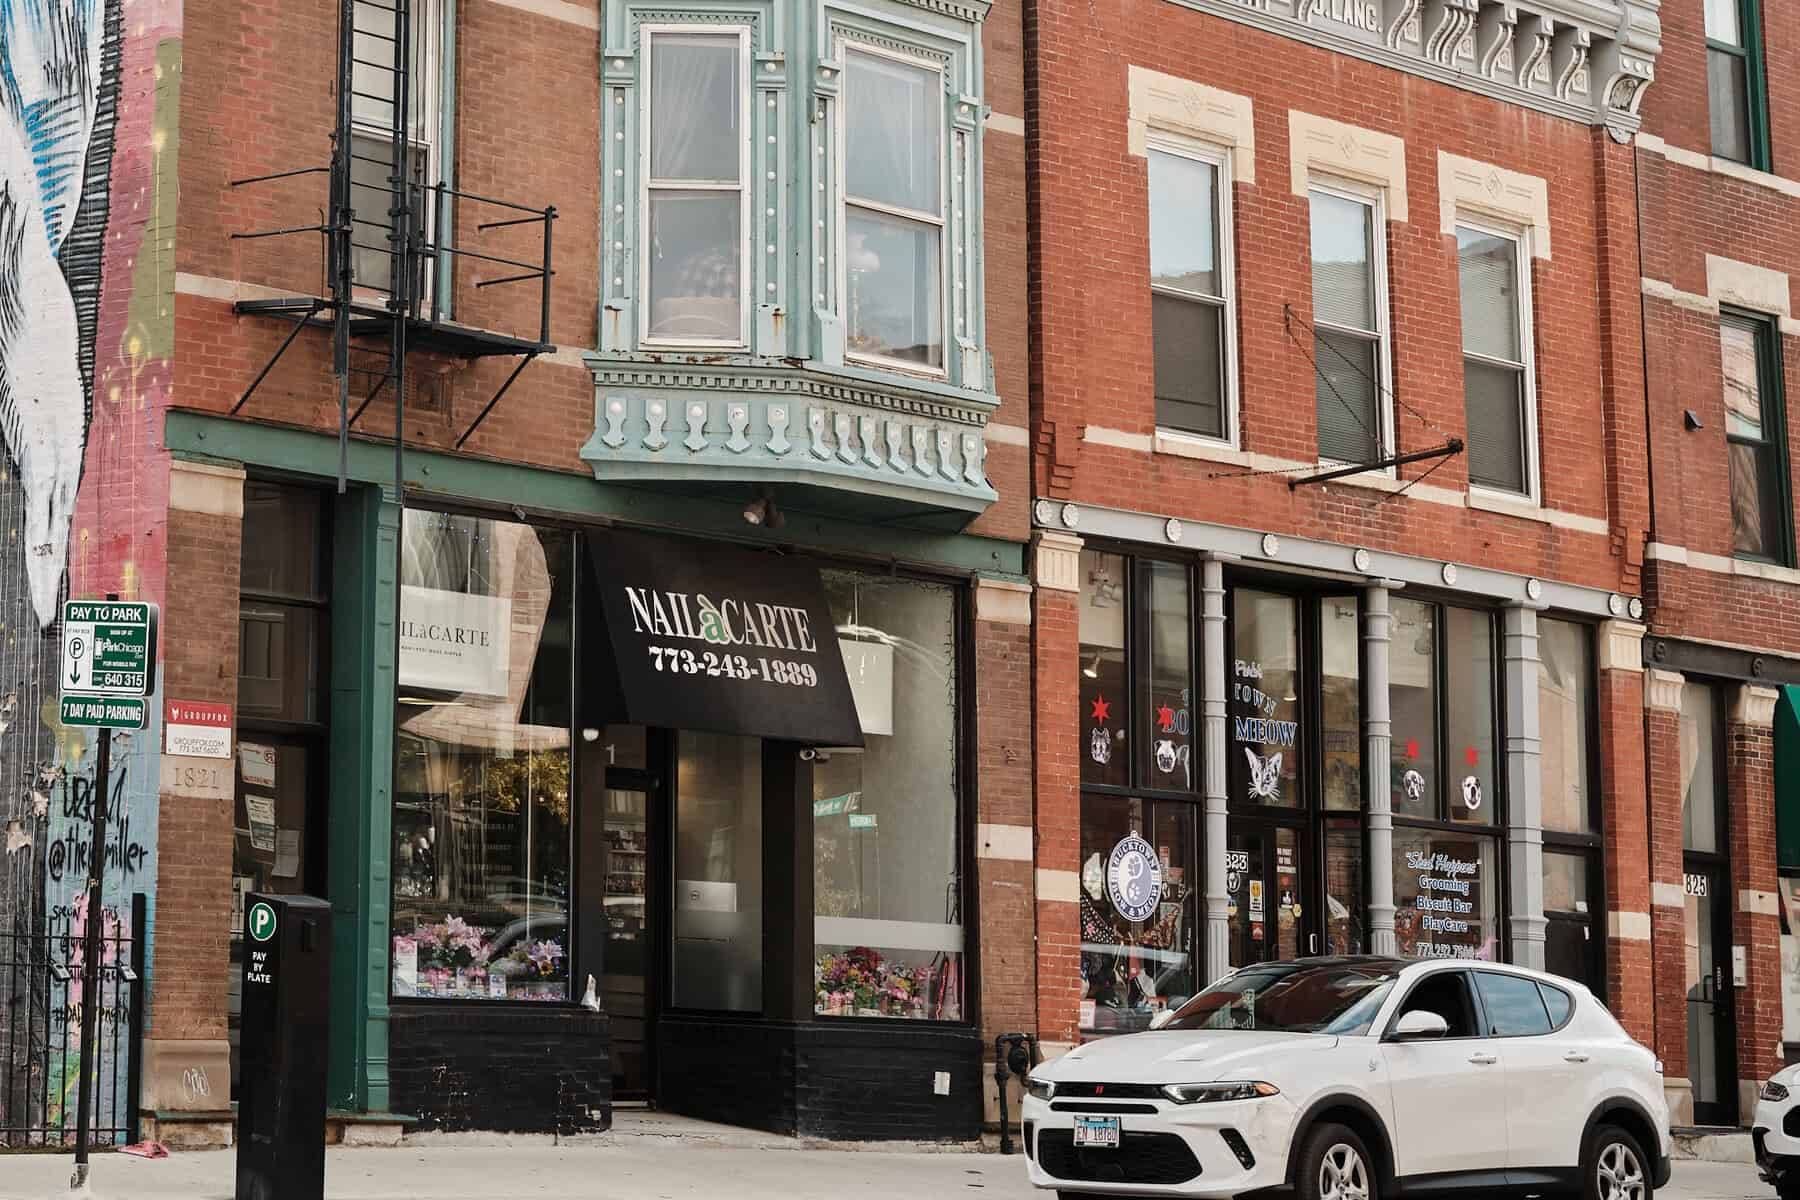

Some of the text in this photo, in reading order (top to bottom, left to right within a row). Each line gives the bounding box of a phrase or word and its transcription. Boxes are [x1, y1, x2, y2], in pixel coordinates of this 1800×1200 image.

[71, 607, 142, 621] PAY TO PARK
[649, 645, 818, 687] 773-243-1889
[104, 674, 122, 686] 640
[124, 674, 143, 686] 315
[63, 703, 142, 721] 7 DAY PAID PARKING
[183, 711, 228, 722] GROUPFOX
[1235, 716, 1298, 747] MEOW
[173, 766, 220, 790] 1821
[1419, 874, 1470, 896] Grooming
[1686, 875, 1706, 895] 825
[1416, 896, 1473, 914] Biscuit Bar
[1422, 916, 1468, 934] PlayCare
[252, 952, 267, 961] PAY
[253, 963, 264, 972] BY
[247, 972, 272, 983] PLATE
